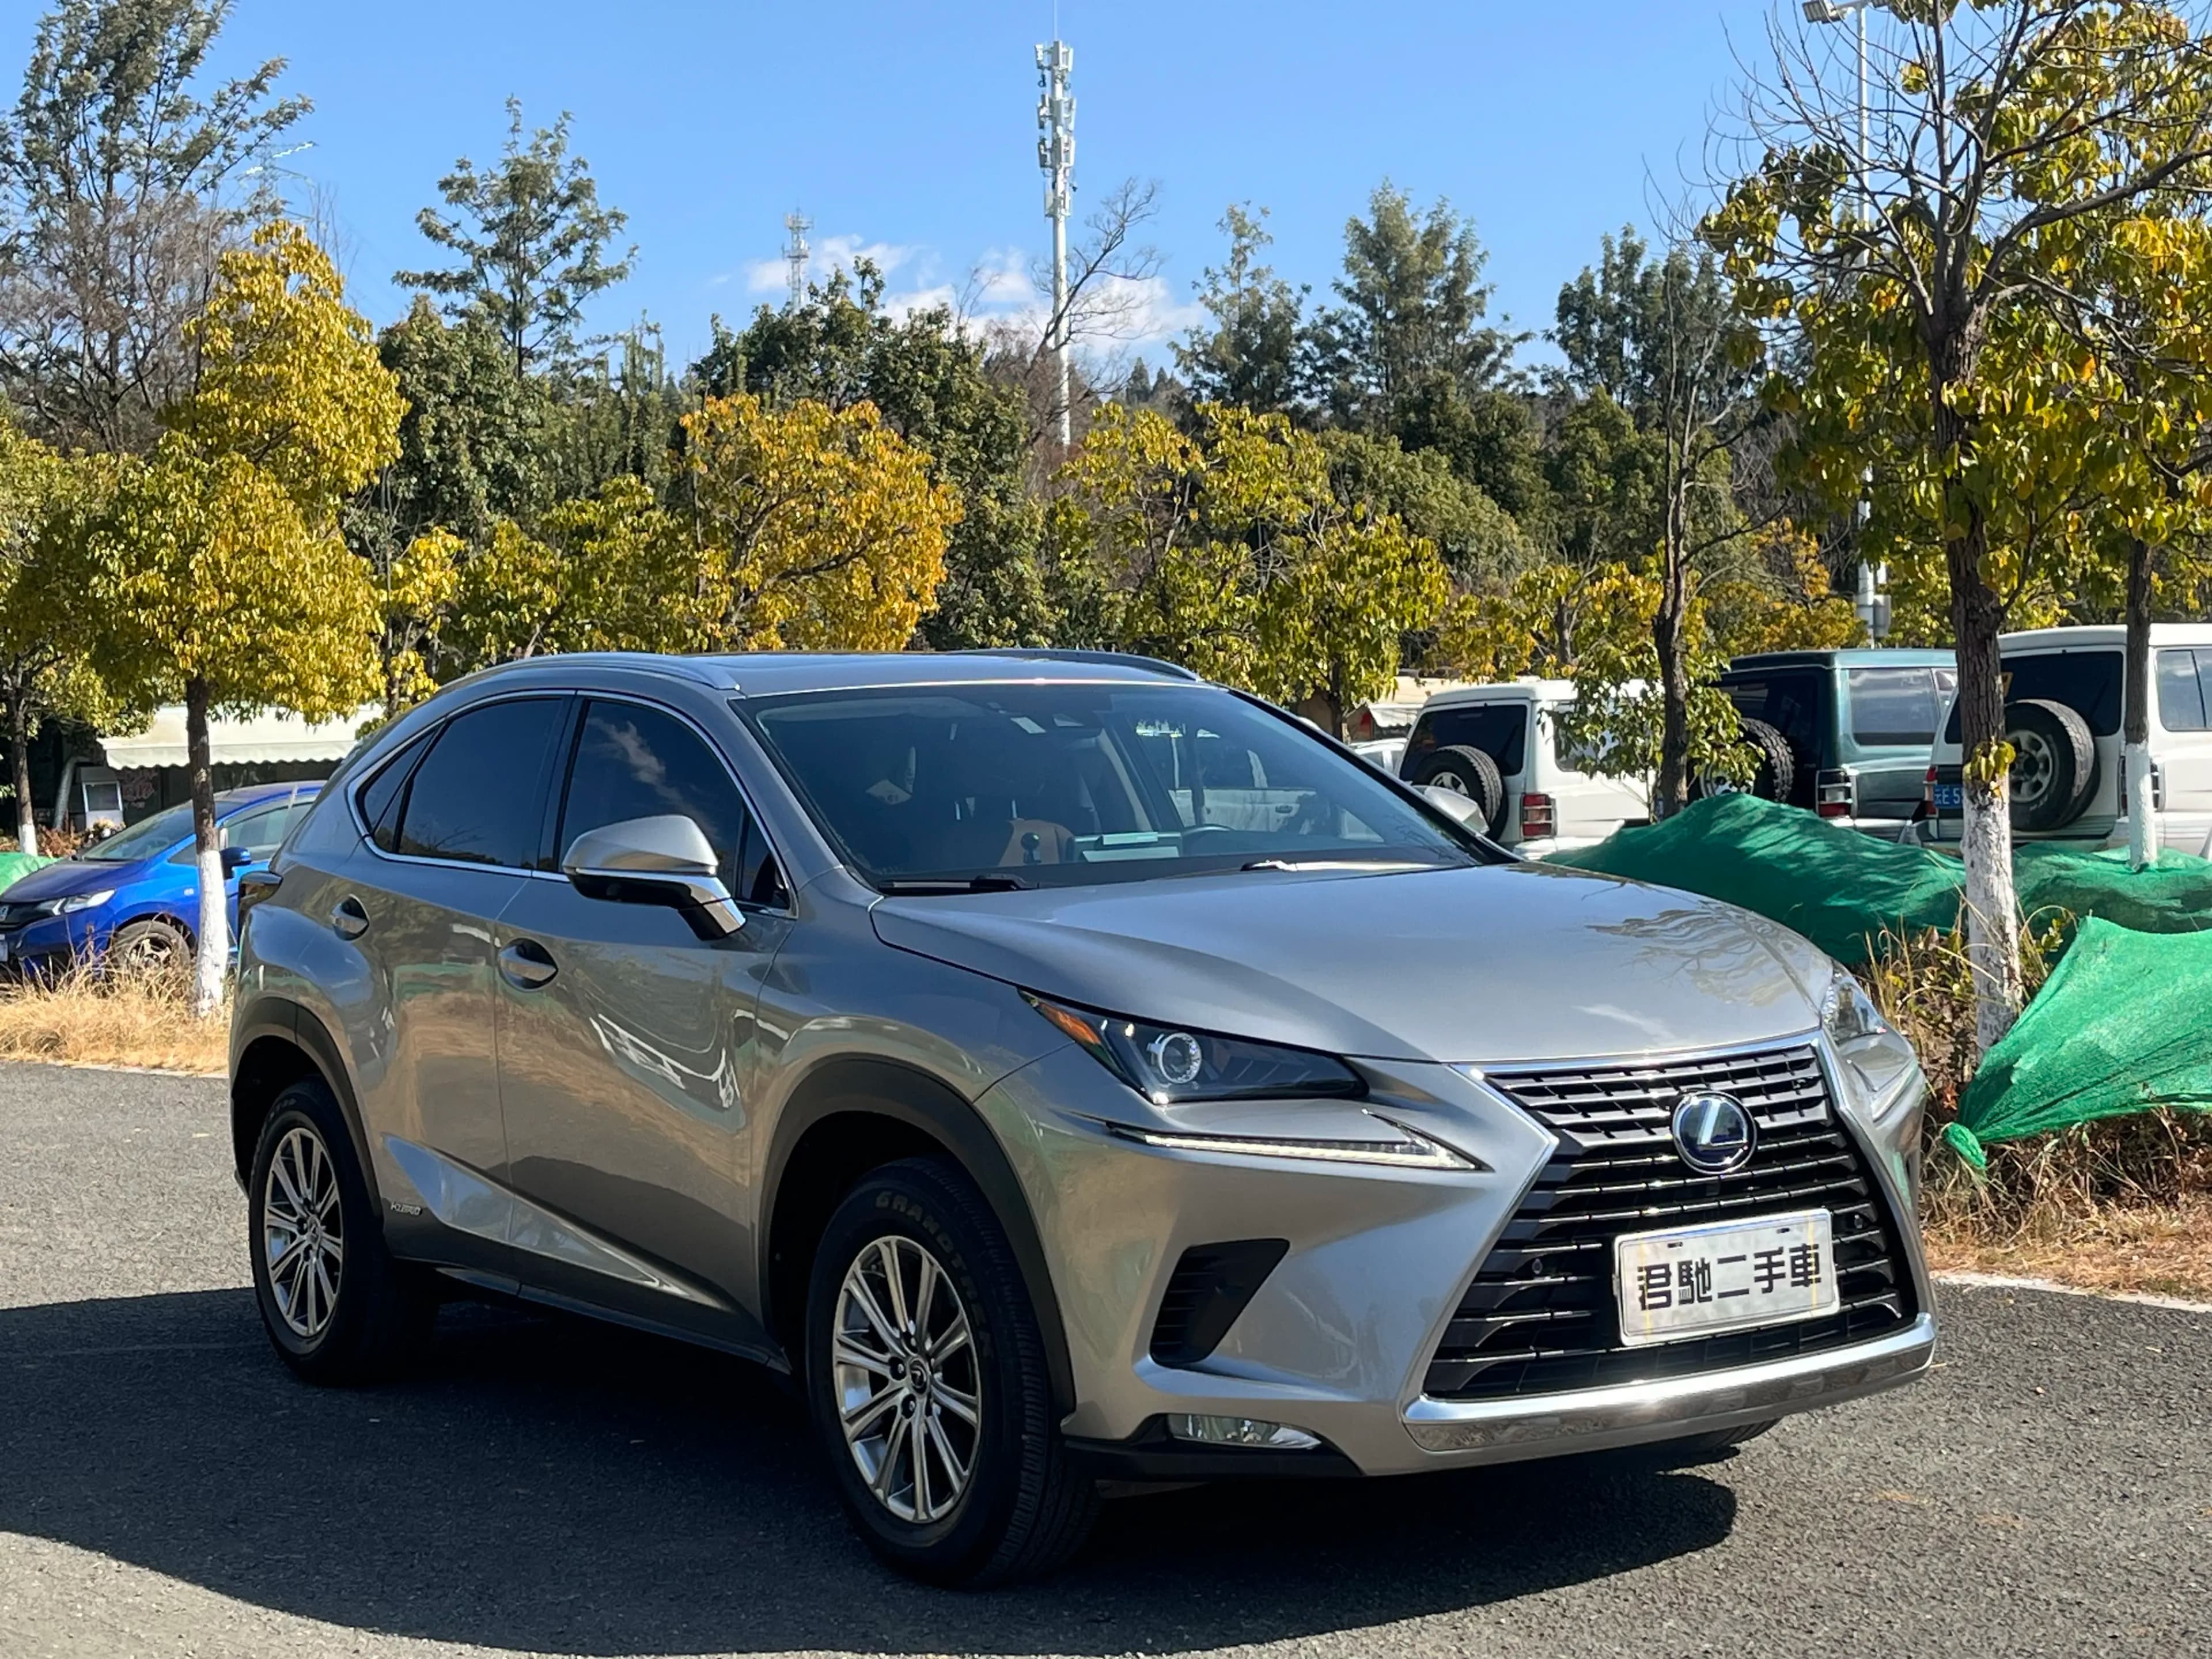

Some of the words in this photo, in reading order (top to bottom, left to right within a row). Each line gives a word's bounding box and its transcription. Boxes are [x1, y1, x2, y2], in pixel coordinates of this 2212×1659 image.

[1637, 1243, 1822, 1311] 君馳二手車
